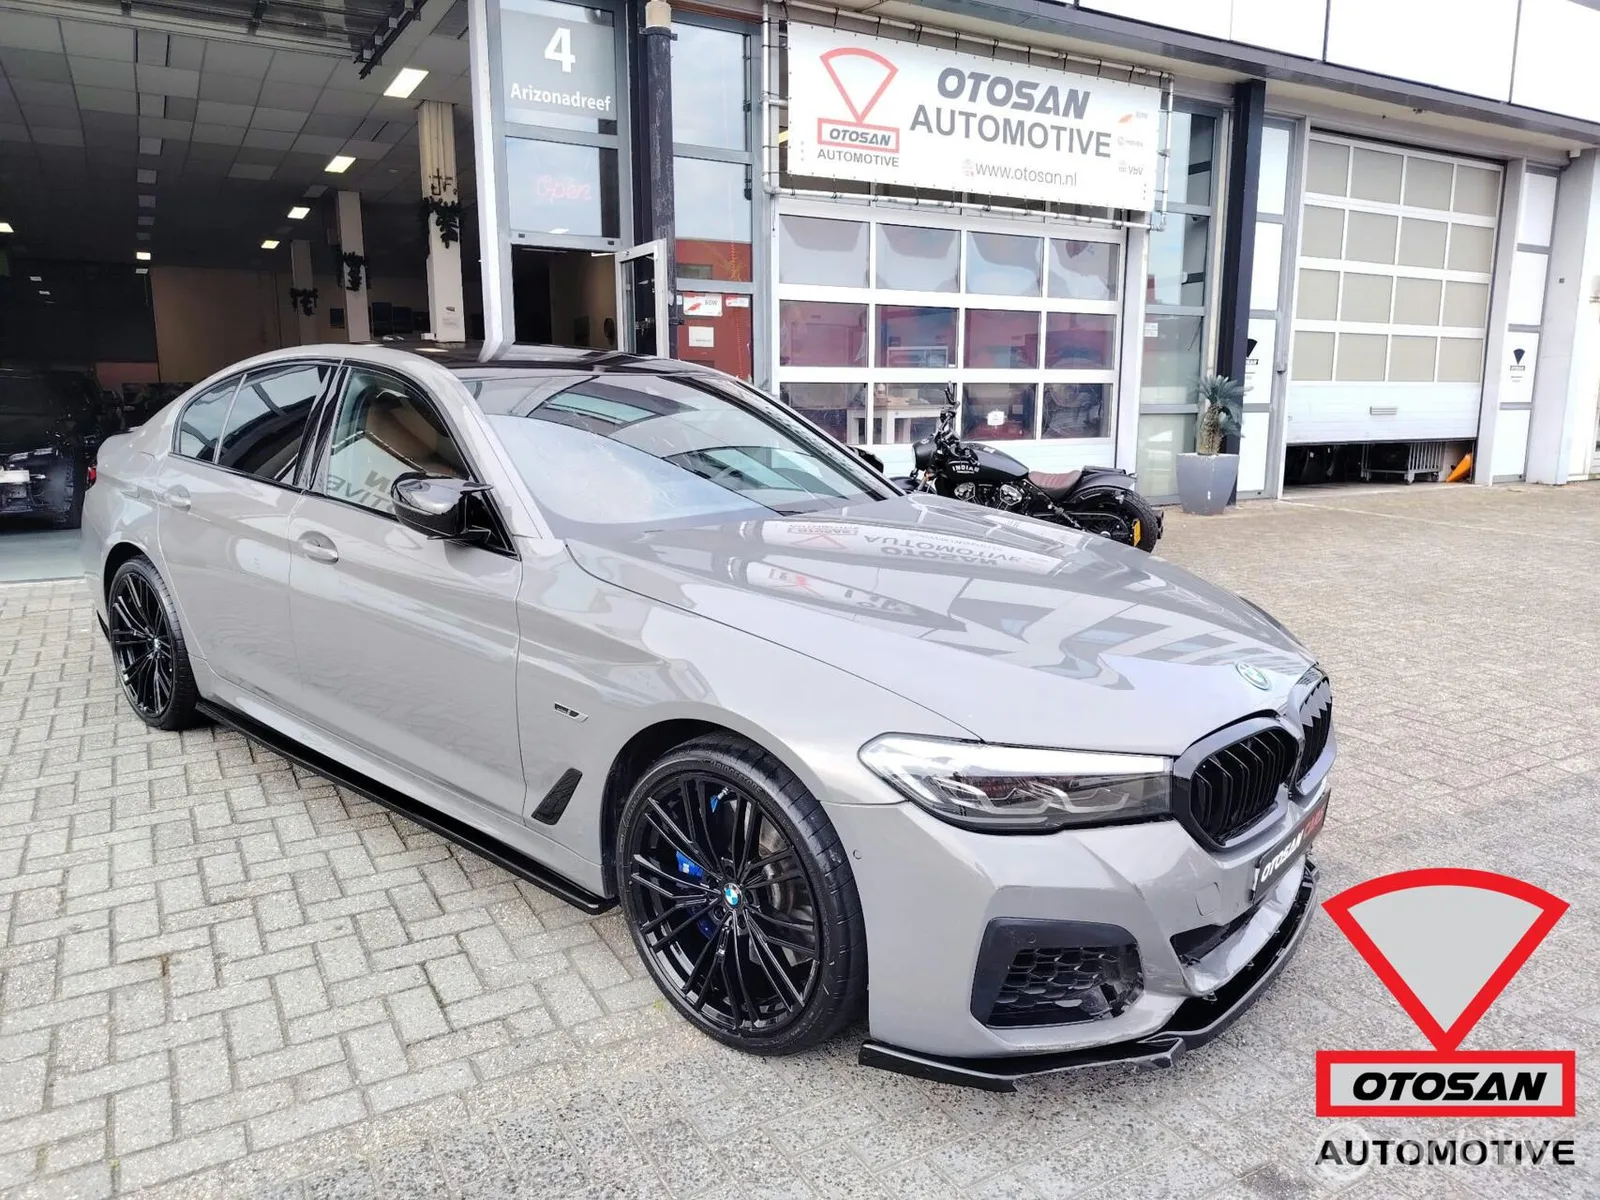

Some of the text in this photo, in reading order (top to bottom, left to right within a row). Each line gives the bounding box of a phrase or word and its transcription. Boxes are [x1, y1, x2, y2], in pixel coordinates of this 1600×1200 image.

[544, 27, 576, 73] 4
[510, 82, 611, 112] Arizonadreef
[937, 67, 1091, 120] OTOSAN
[829, 127, 892, 147] OTOSAN
[909, 104, 1112, 159] AUTOMOTIVE
[817, 148, 900, 168] AUTOMOTIVE
[975, 161, 1078, 187] www.otosan.nl
